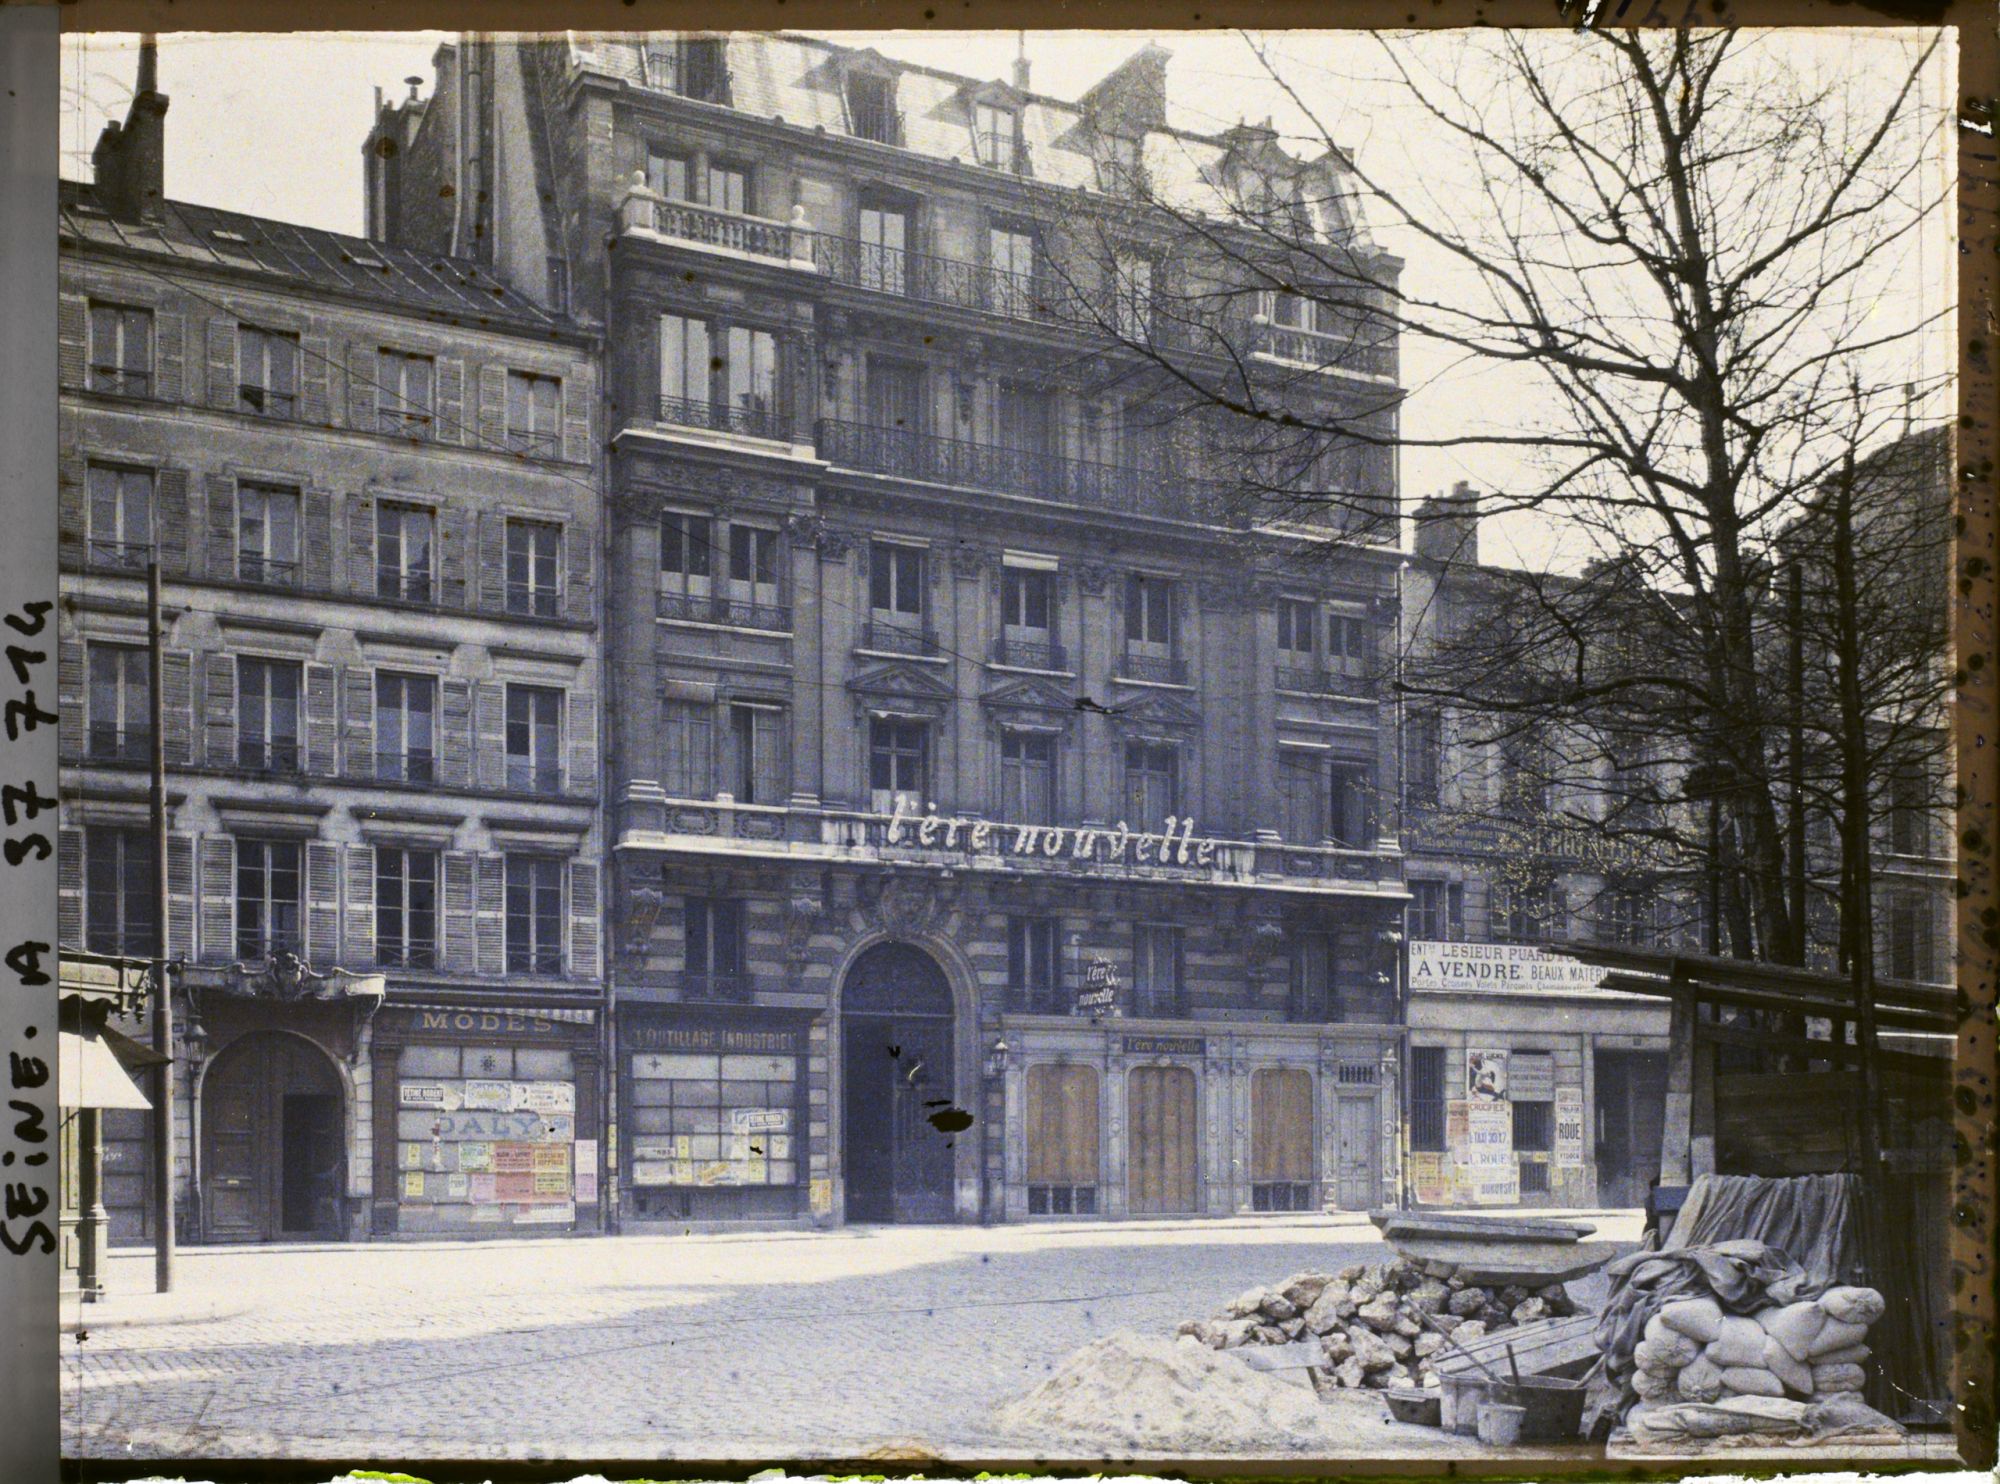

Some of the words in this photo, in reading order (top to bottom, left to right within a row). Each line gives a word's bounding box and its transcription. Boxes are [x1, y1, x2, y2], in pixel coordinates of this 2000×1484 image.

[1013, 814, 1216, 866] nouvelle
[5, 940, 52, 986] A
[1442, 945, 1503, 960] LESIEUR
[1417, 960, 1432, 976] A
[1531, 965, 1564, 981] BEAUX
[422, 1012, 553, 1033] MODES
[1559, 1122, 1581, 1140] ROUE
